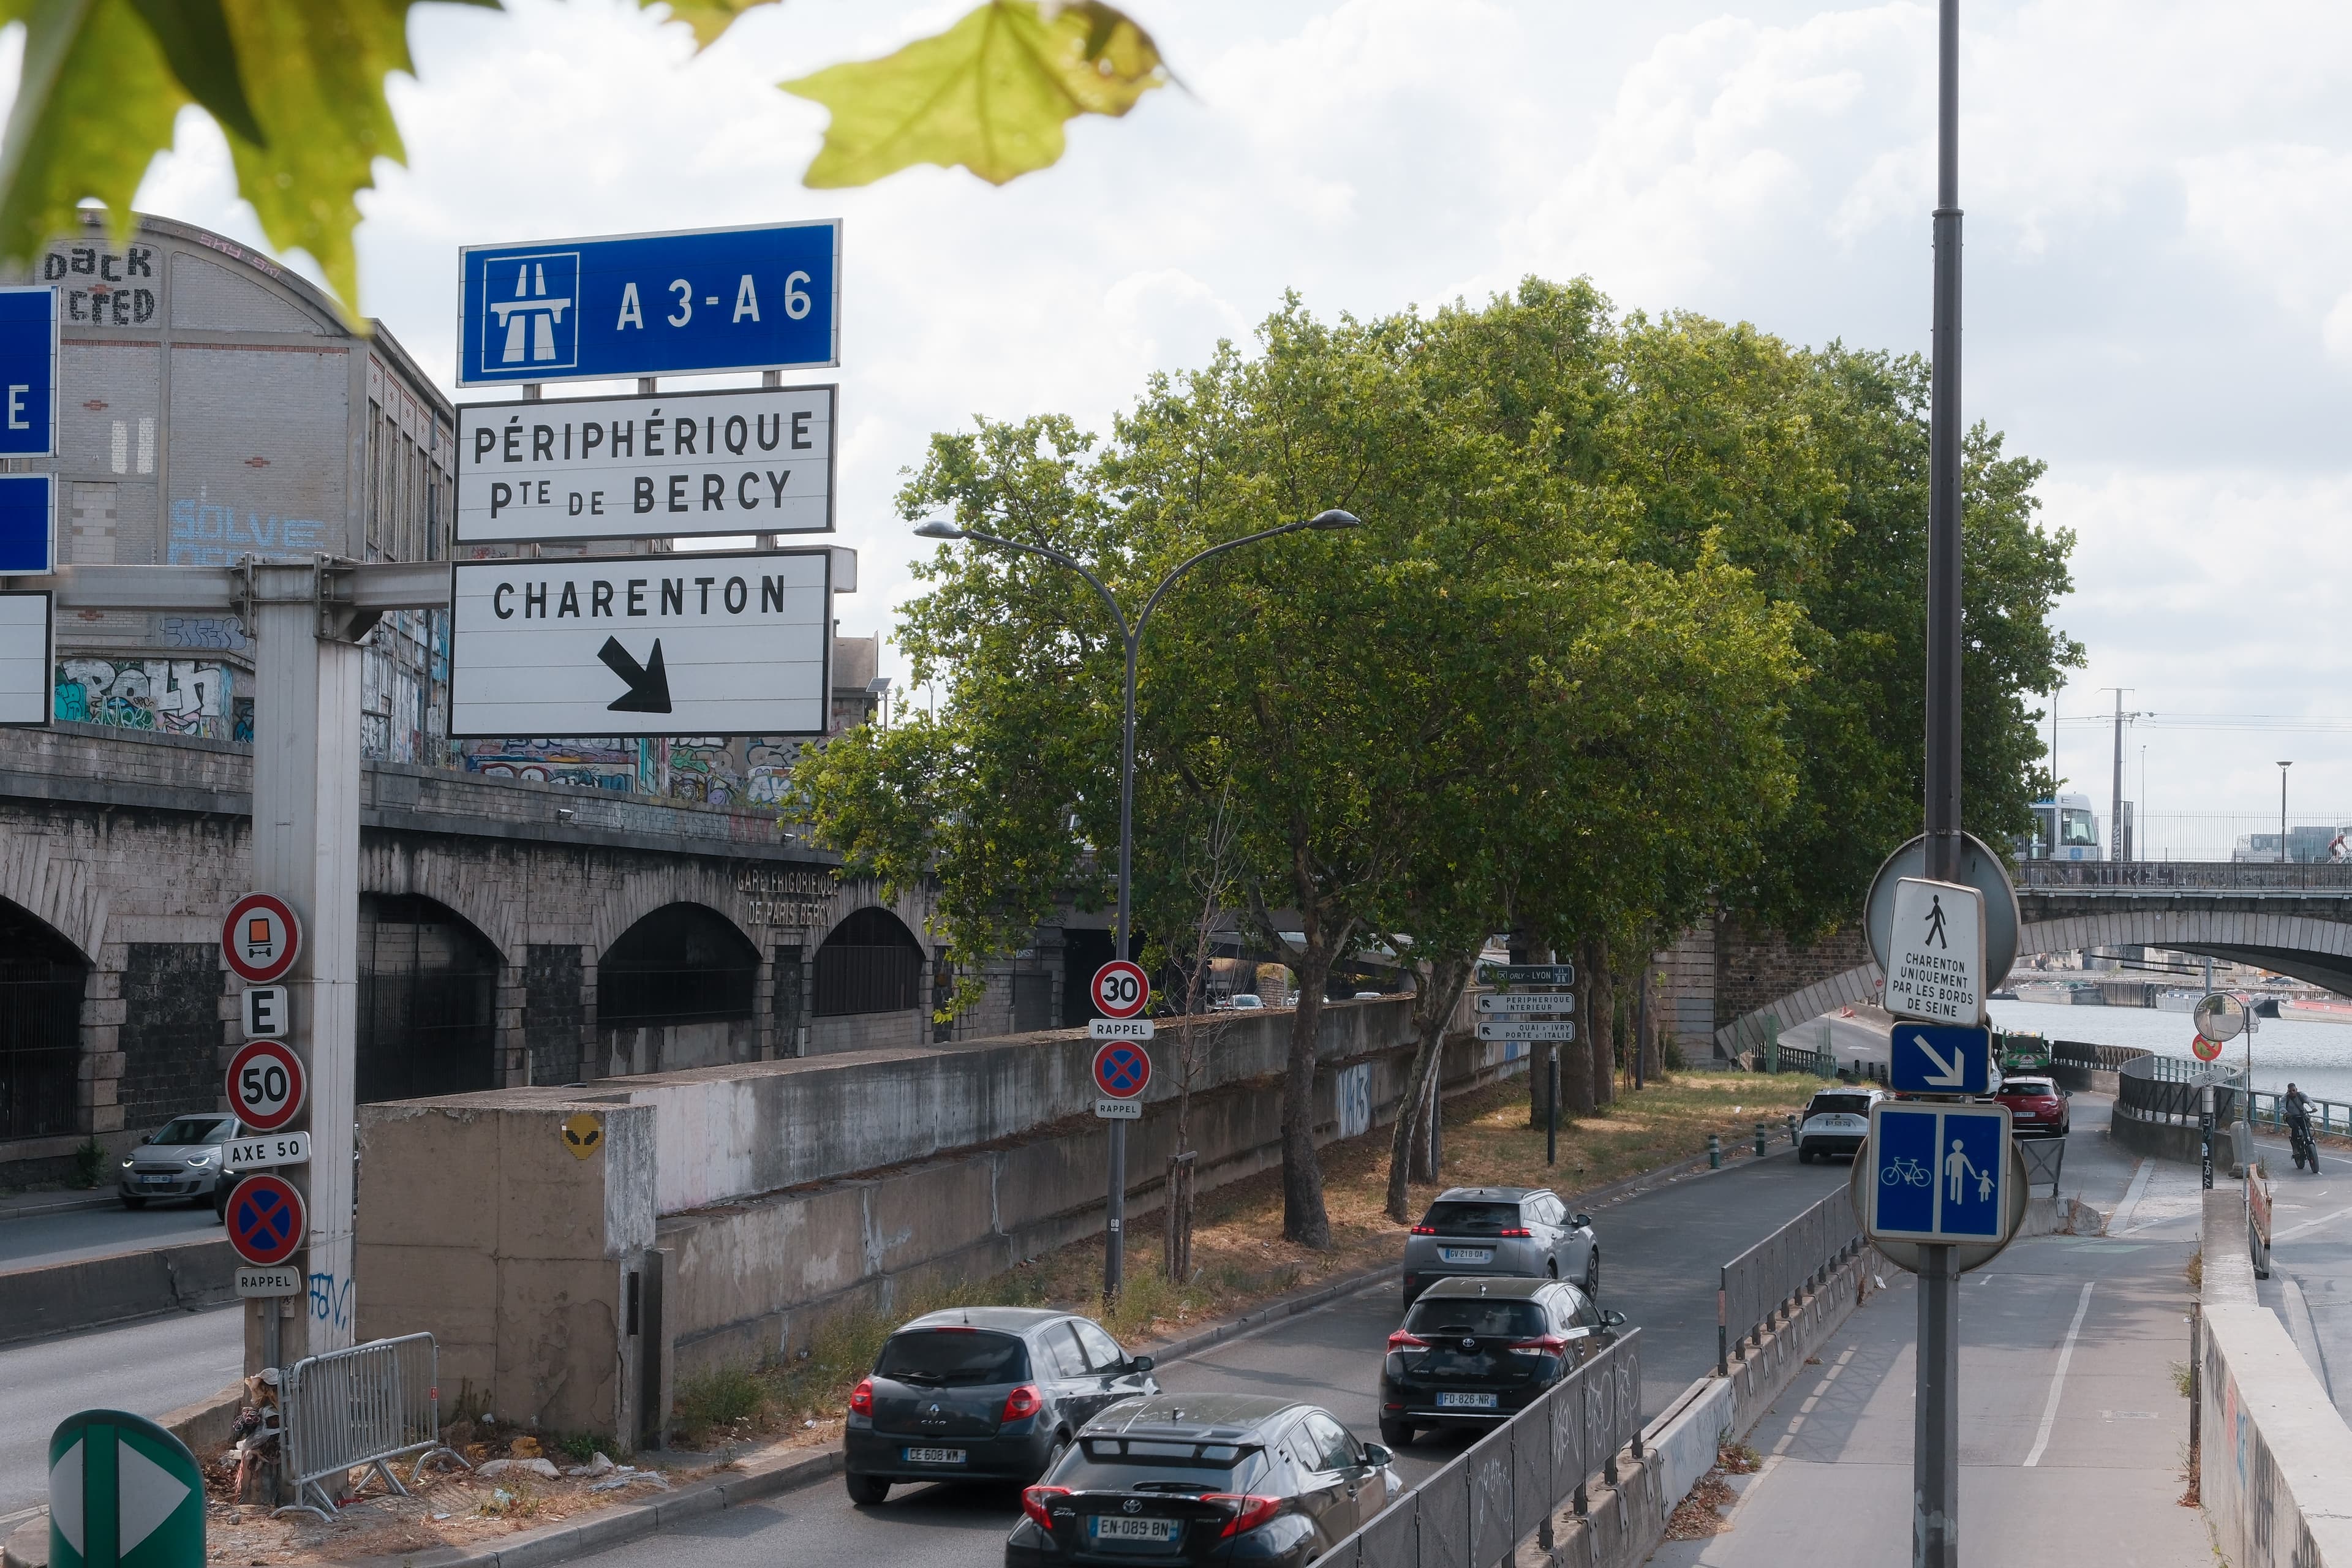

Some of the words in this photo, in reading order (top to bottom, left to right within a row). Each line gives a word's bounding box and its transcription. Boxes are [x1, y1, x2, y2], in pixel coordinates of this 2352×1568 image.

[617, 282, 643, 330] A
[784, 271, 811, 320] 6
[475, 409, 812, 464] PÉRIPHÉRIQUE
[569, 491, 604, 516] DE
[634, 470, 791, 513] BERCY
[494, 575, 784, 619] CHARENTON
[737, 869, 766, 892] GARE
[772, 871, 839, 897] FRIGORIFIQUE
[748, 901, 762, 924] DE
[767, 902, 795, 925] PARIS
[801, 903, 832, 926] BERCY
[1906, 952, 1964, 973] CHARENTON
[1102, 976, 1138, 1002] 30
[1901, 966, 1967, 989] UNIQUEMENT
[1893, 980, 1912, 993] PAR
[1917, 984, 1935, 998] LES
[1939, 988, 1973, 1005] BORDS
[251, 990, 275, 1034] E
[1907, 998, 1921, 1011] DE
[1926, 1001, 1957, 1017] SEINE
[1097, 1025, 1145, 1035] RAPPEL
[243, 1066, 287, 1104] 50
[232, 1144, 266, 1163] AXE
[277, 1140, 299, 1157] 50
[241, 1275, 291, 1288] RAPPEL
[1444, 1393, 1490, 1404] FD-826-NR
[1102, 1519, 1169, 1536] EN-089-BN
